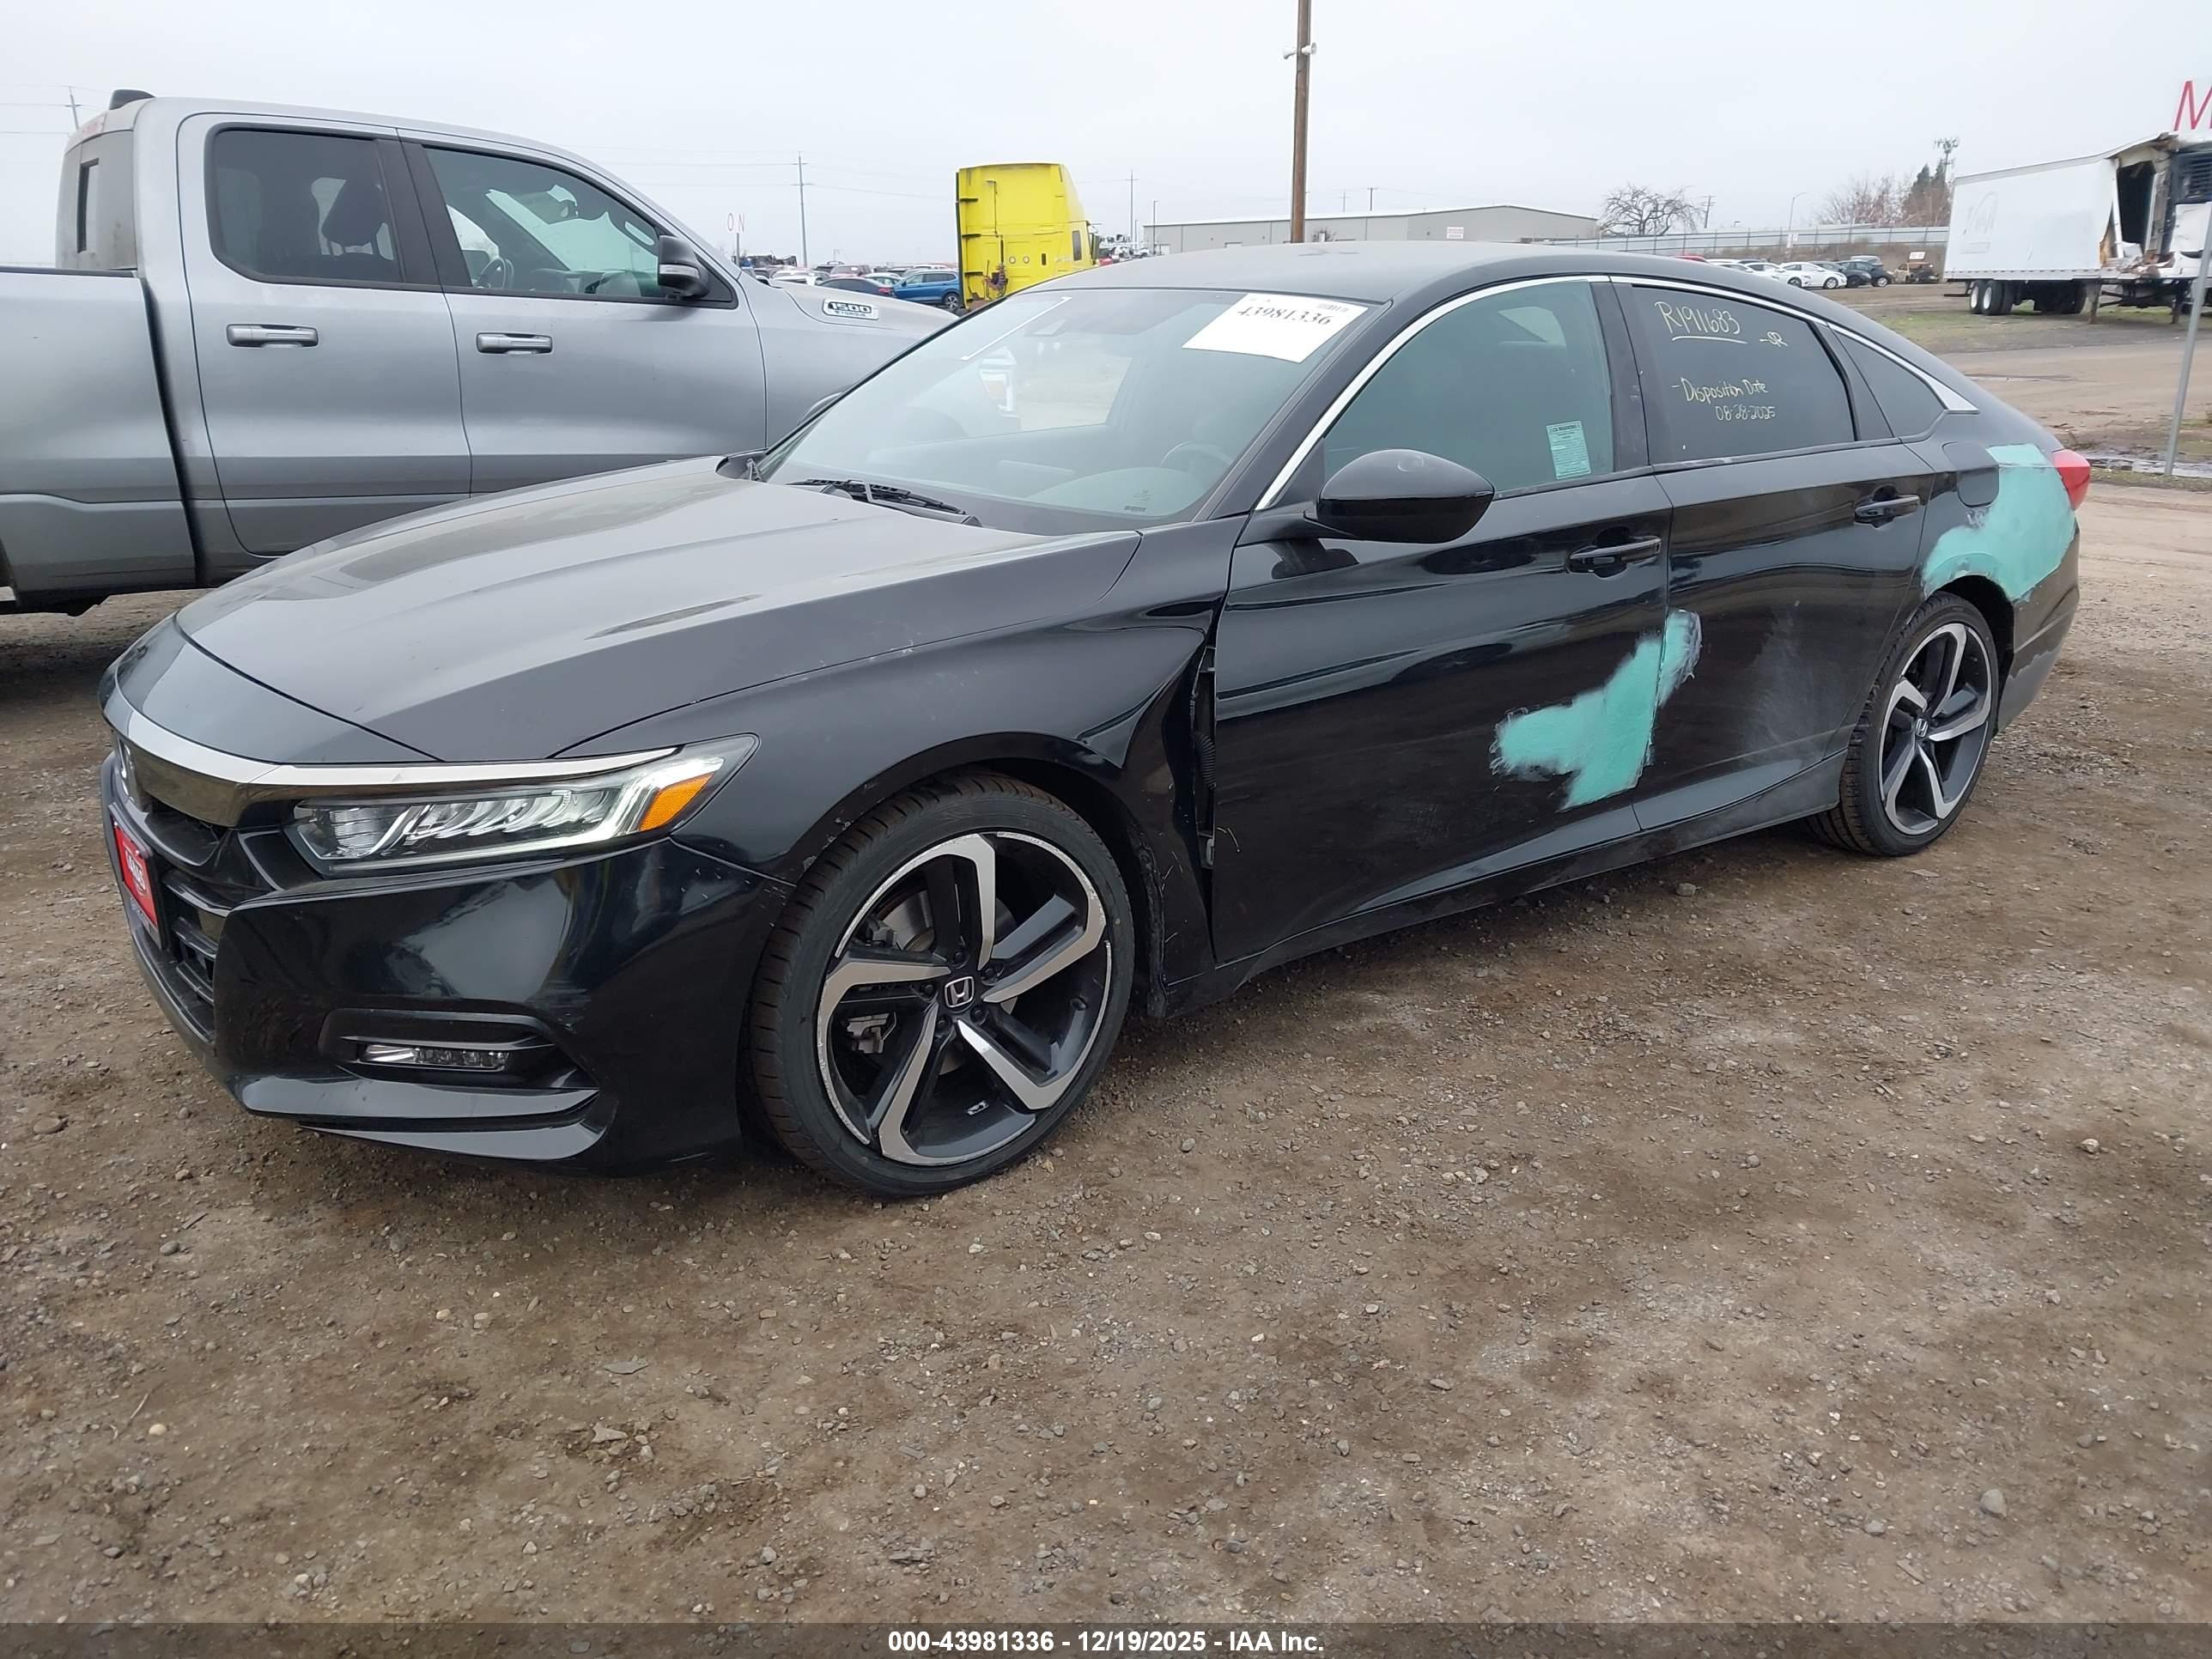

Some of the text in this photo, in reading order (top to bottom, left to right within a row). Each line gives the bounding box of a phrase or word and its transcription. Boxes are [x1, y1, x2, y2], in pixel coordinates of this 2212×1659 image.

[830, 302, 872, 313] 1500
[1237, 306, 1334, 325] 43981336
[1715, 404, 1776, 422] 08-28-2025
